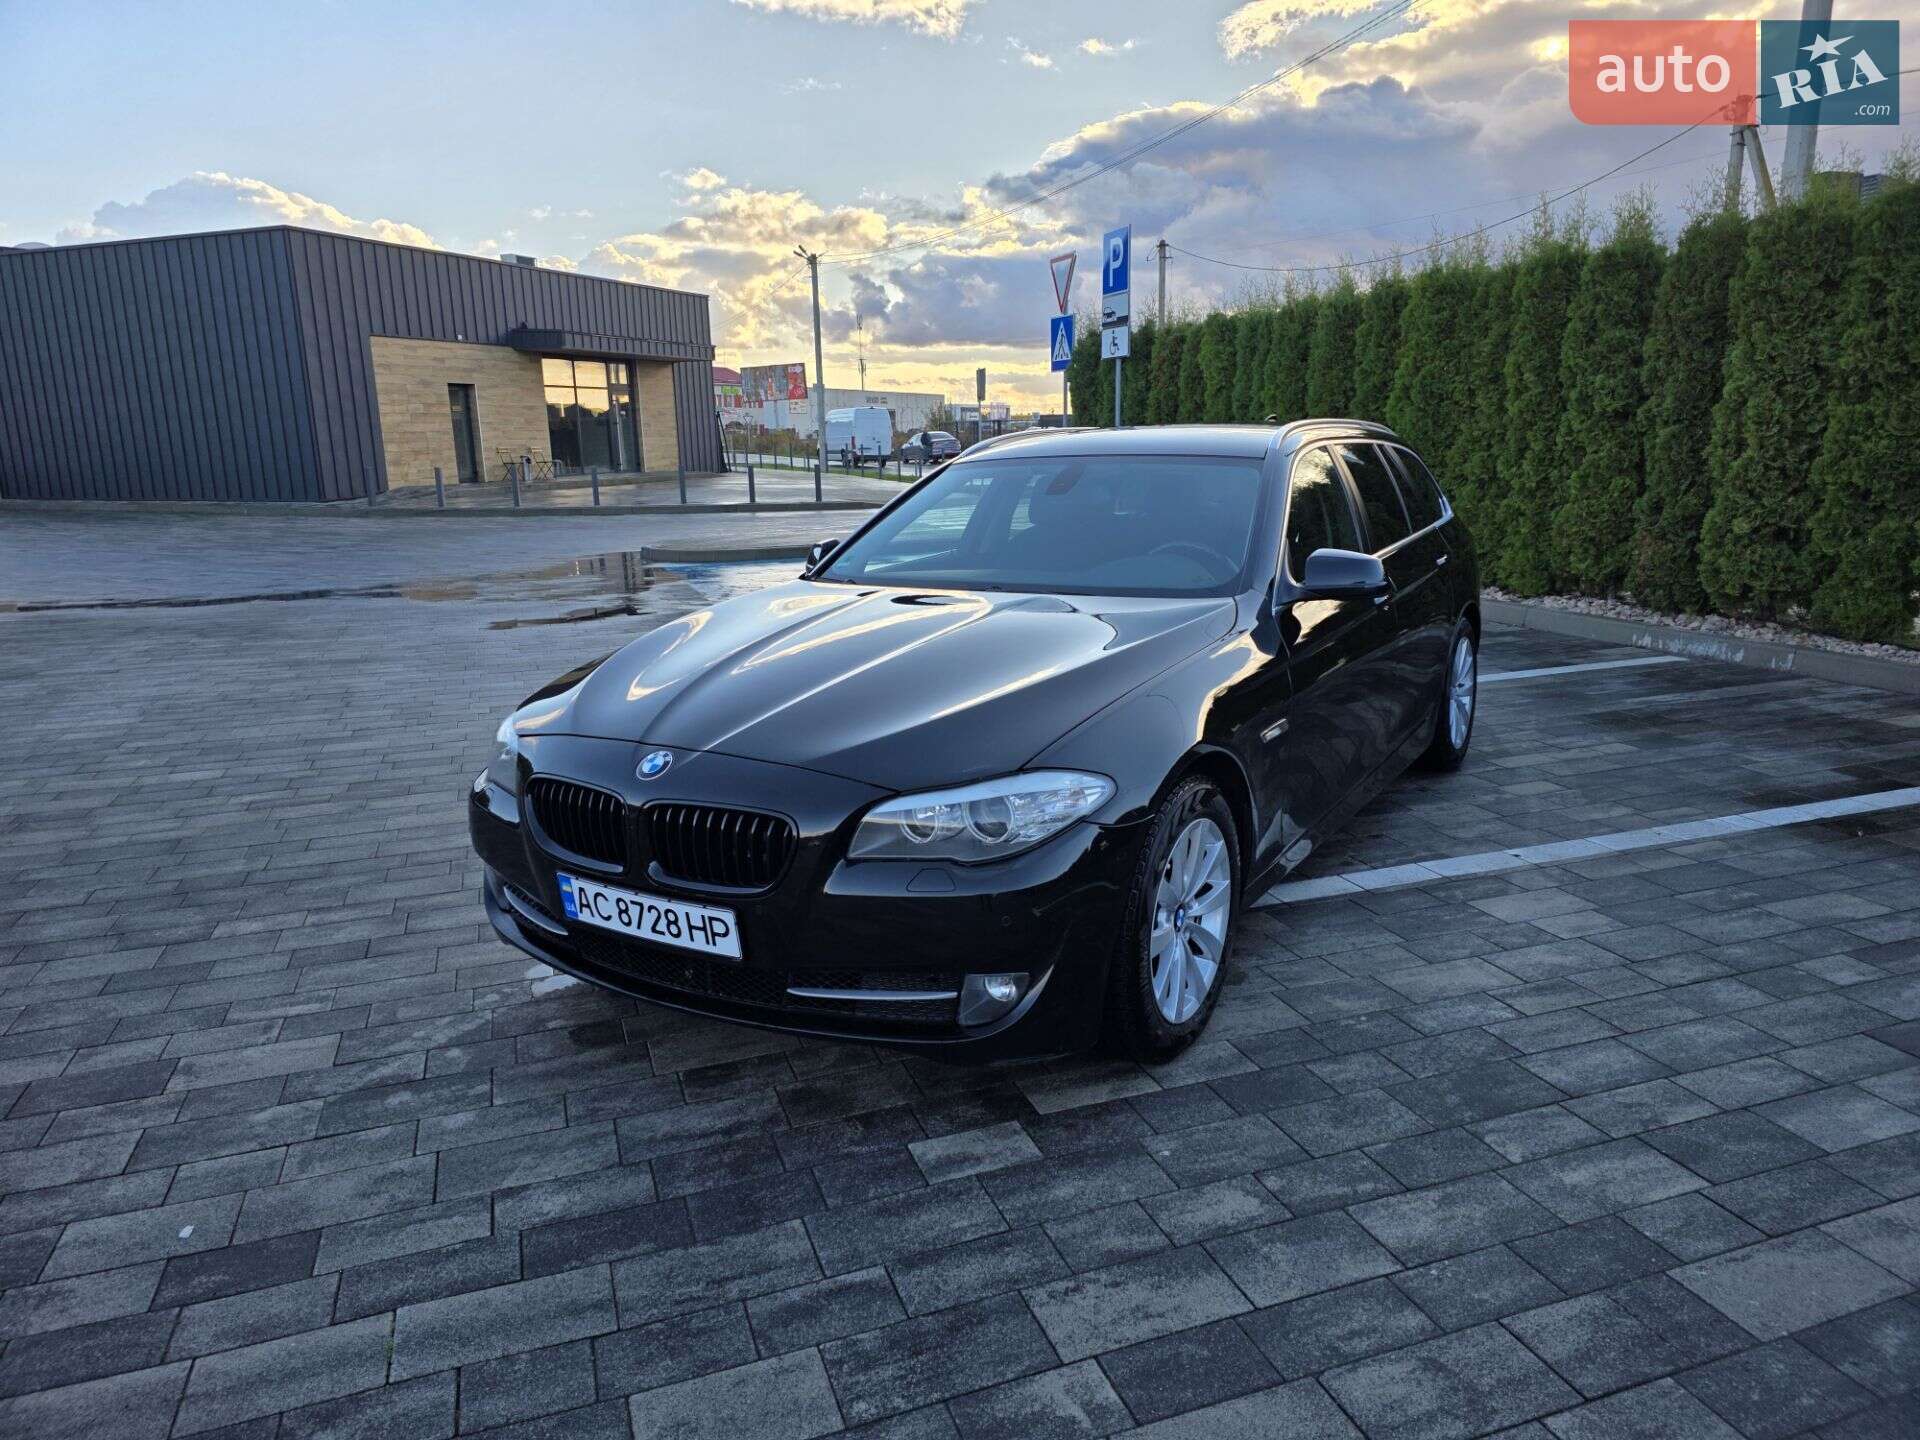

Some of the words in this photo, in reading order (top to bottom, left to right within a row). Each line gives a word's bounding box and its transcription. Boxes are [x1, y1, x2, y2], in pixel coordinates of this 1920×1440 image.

[1109, 236, 1124, 288] P
[578, 887, 612, 921] AC
[615, 897, 682, 939] 8728
[685, 911, 730, 947] HP
